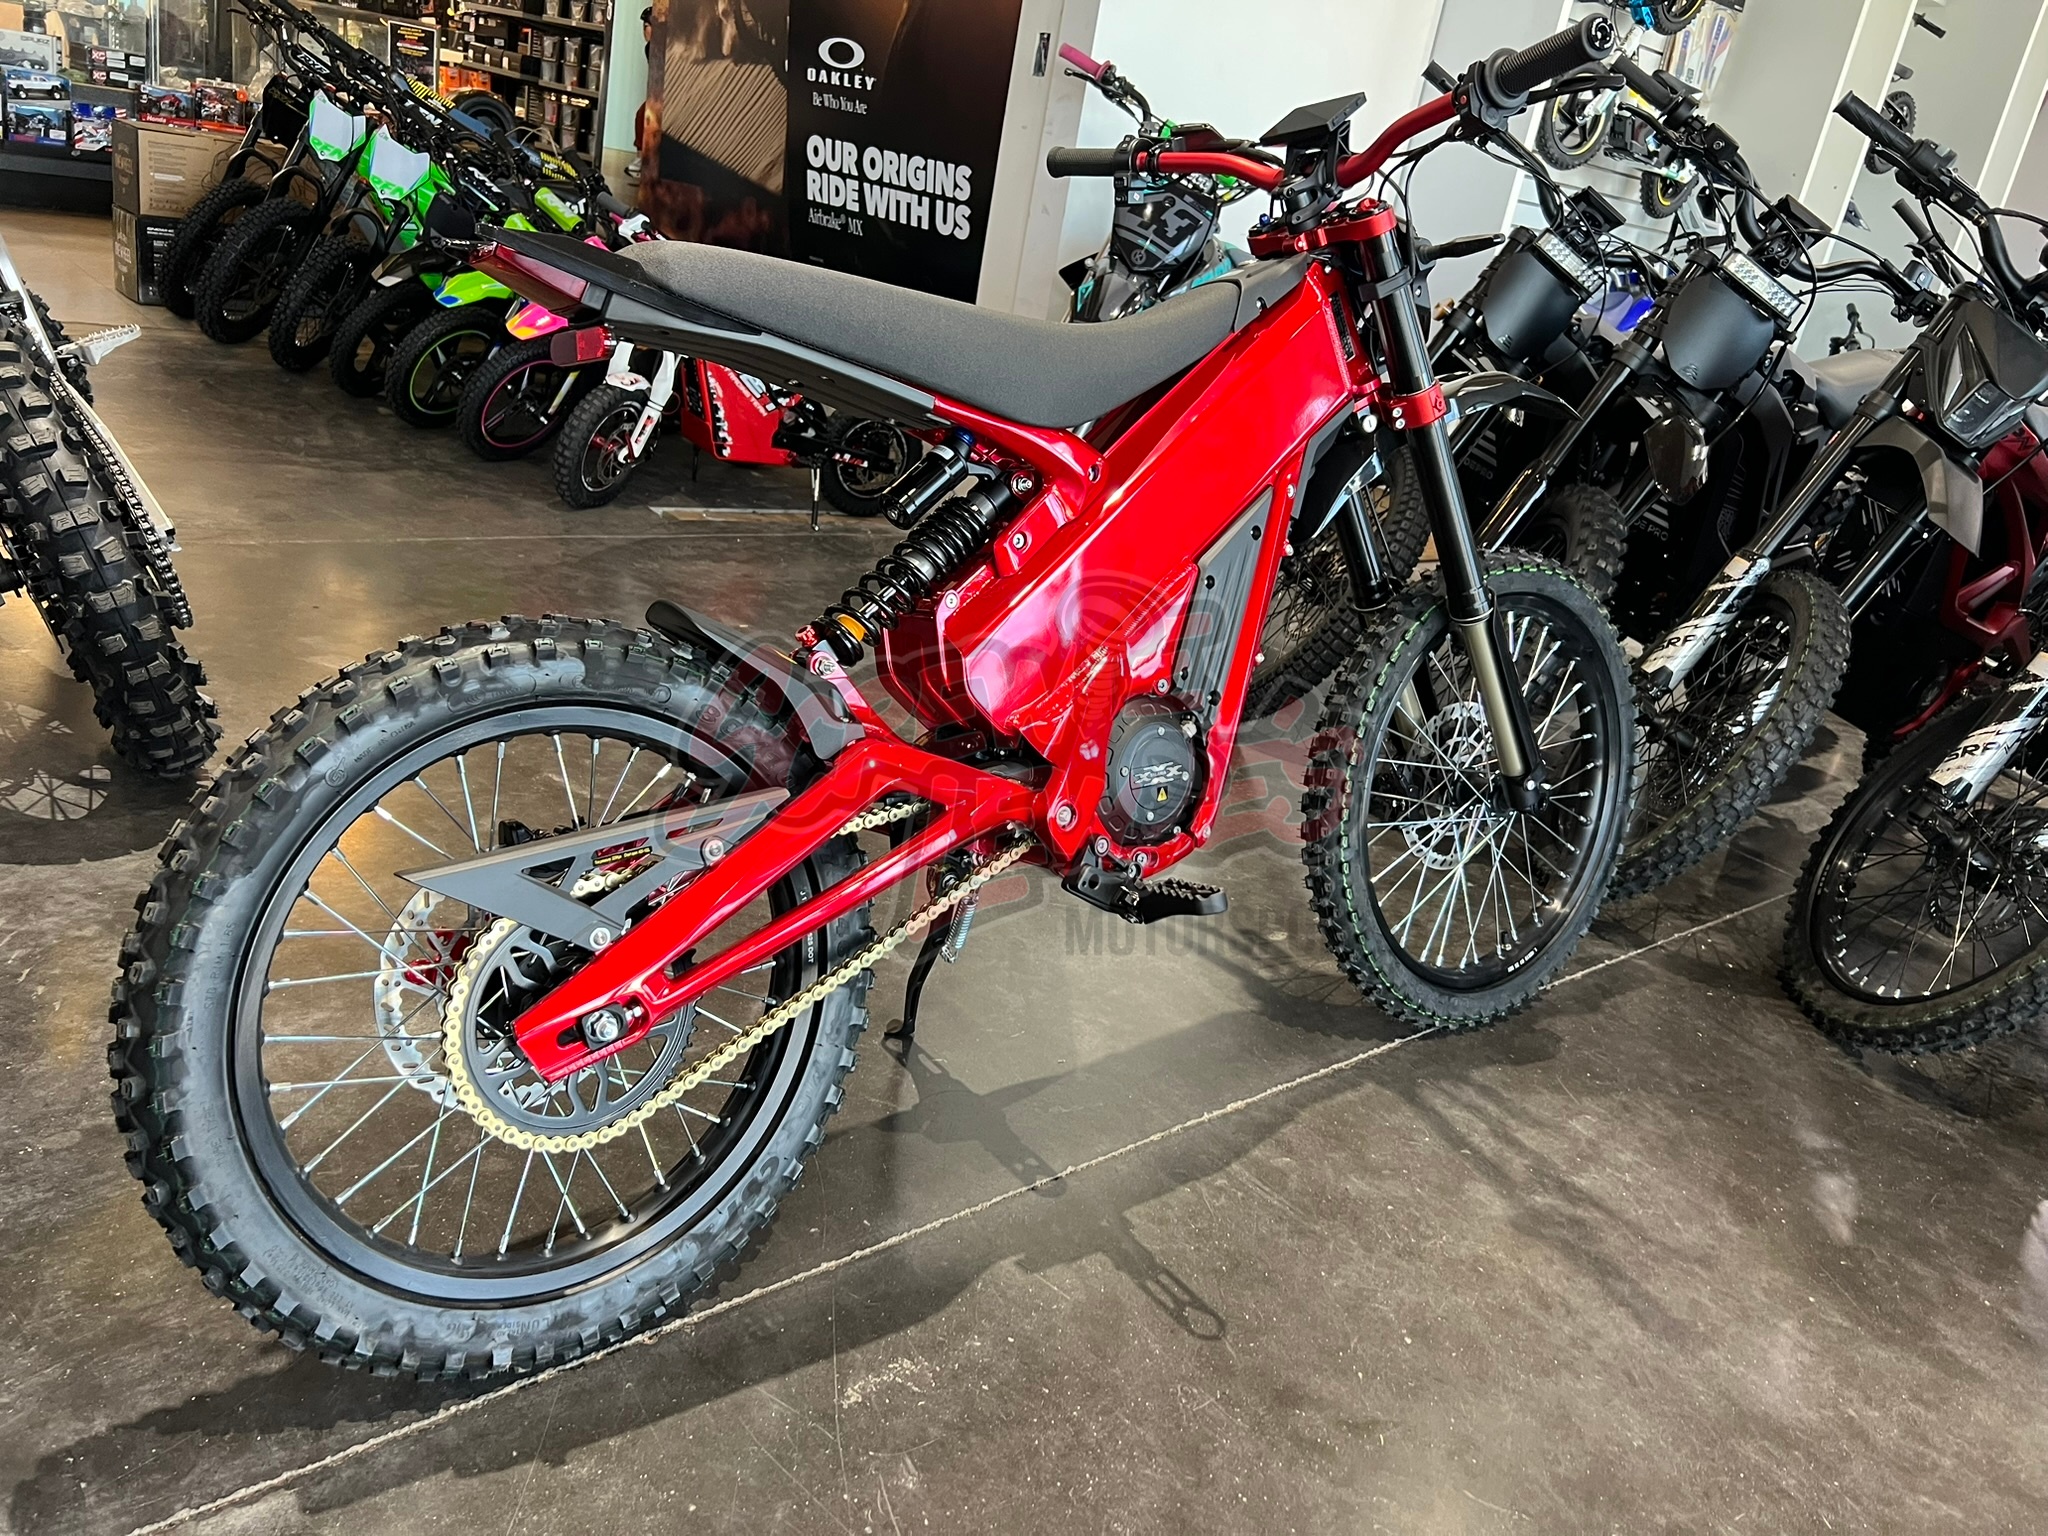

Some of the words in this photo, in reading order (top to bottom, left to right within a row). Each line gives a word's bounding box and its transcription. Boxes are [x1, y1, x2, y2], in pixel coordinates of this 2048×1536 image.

[806, 68, 876, 91] OAKLEY
[812, 92, 823, 107] Be
[823, 93, 840, 110] Who
[840, 96, 854, 113] You
[854, 100, 868, 115] Are
[806, 134, 859, 177] OUR
[862, 145, 973, 202] ORIGINS
[806, 169, 860, 213] RIDE
[863, 181, 930, 231] WITH
[934, 200, 972, 241] US
[847, 217, 864, 237] MX
